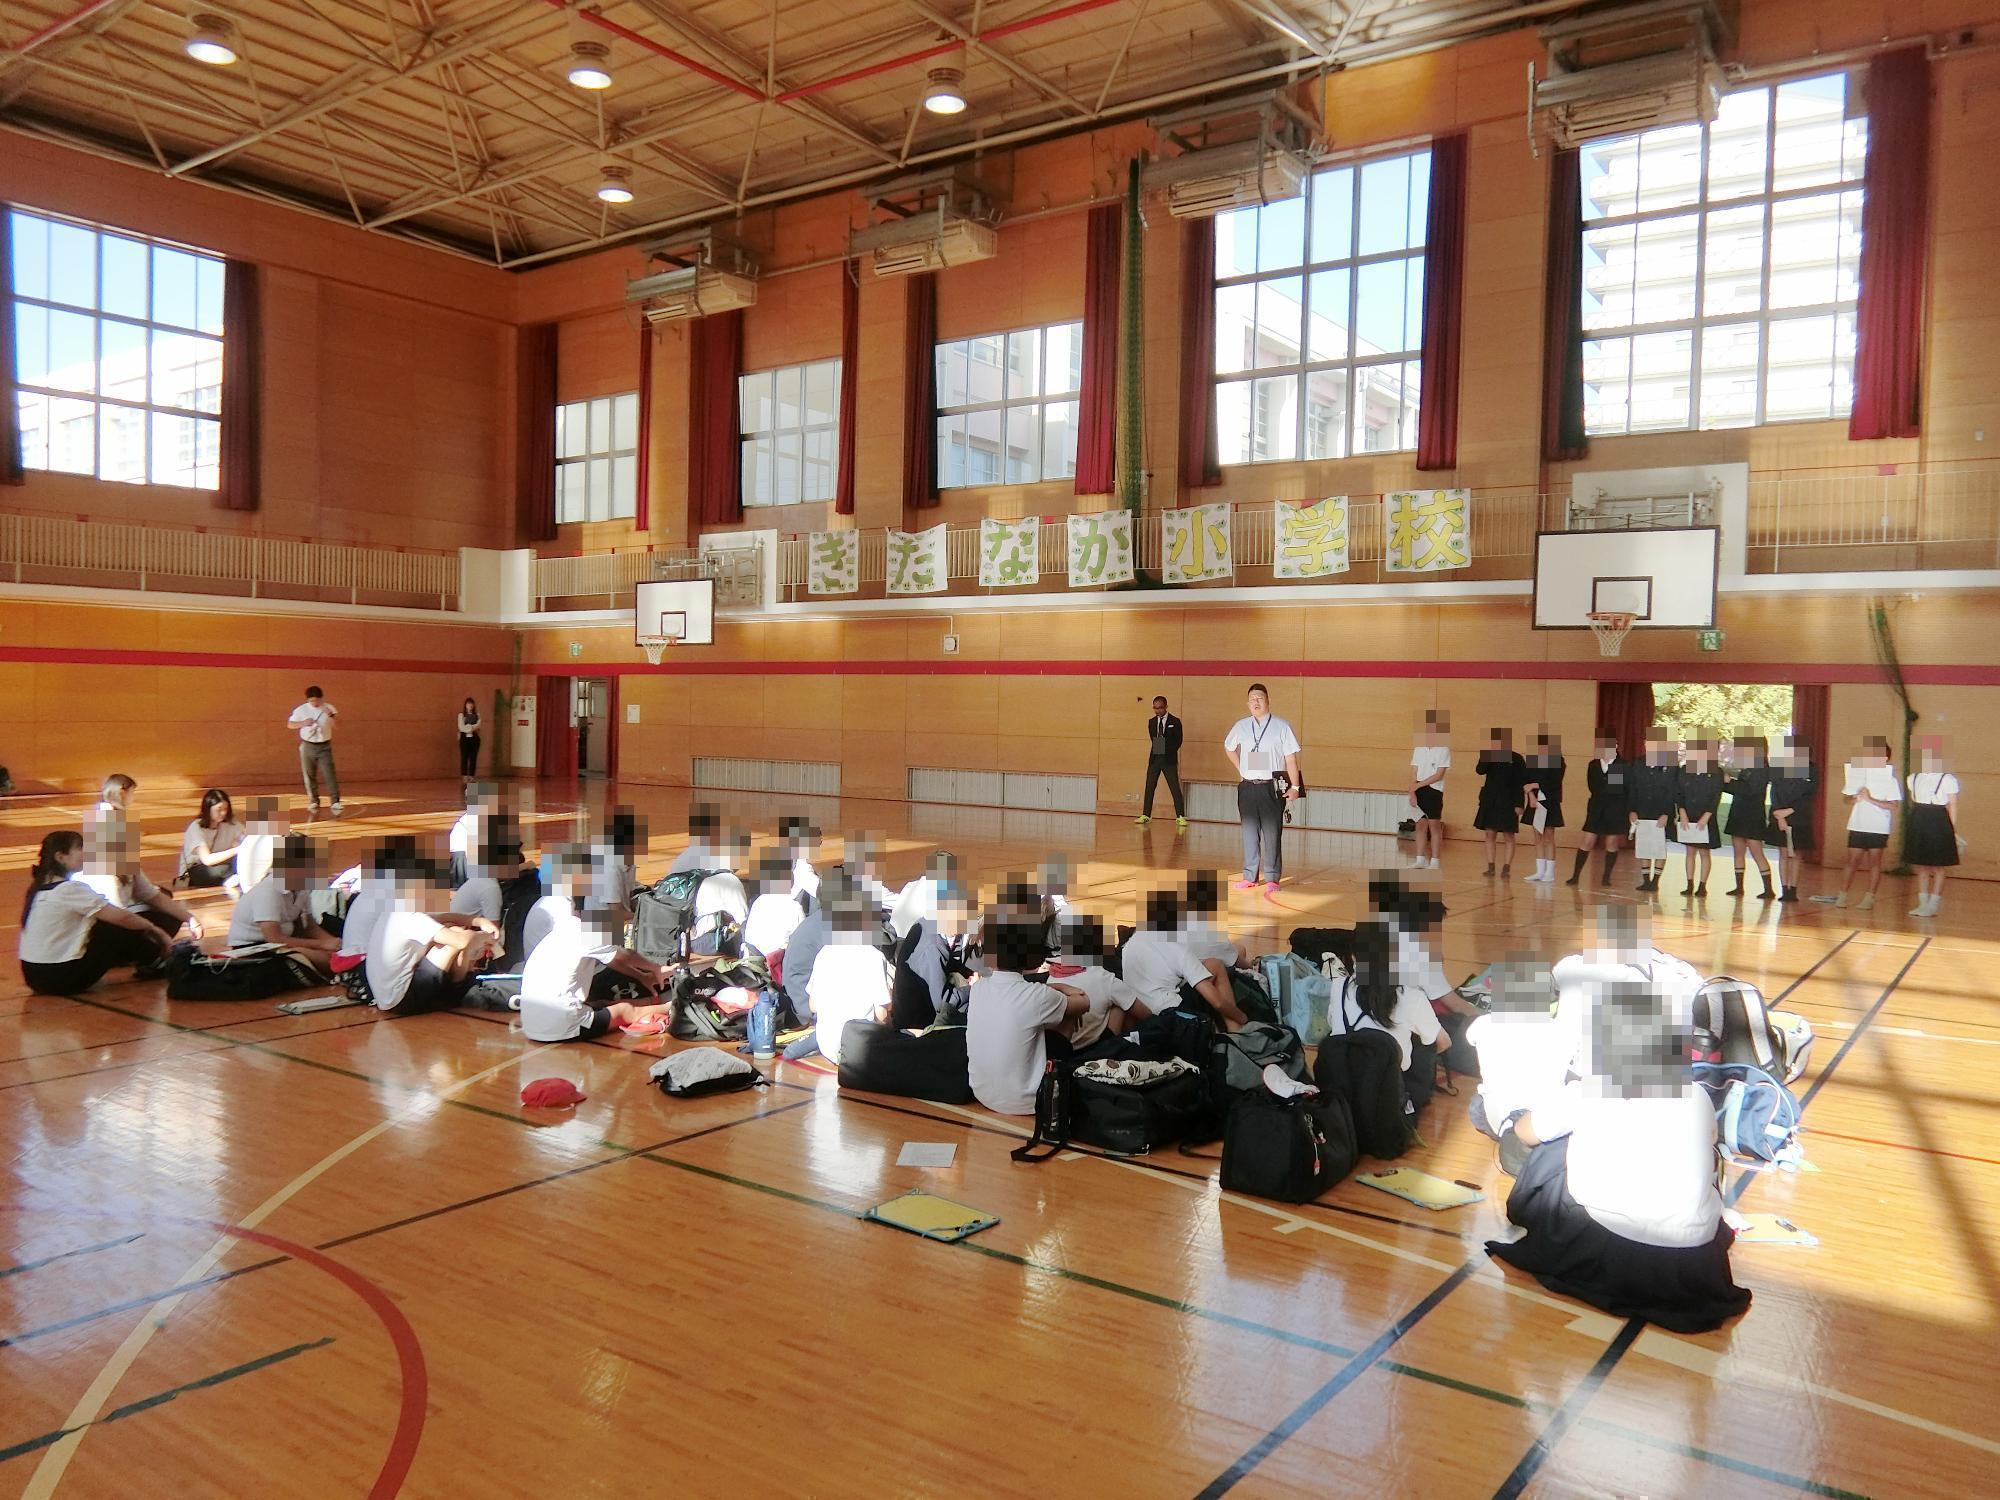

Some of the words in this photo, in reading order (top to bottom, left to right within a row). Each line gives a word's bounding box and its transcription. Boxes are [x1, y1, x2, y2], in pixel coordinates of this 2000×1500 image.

[814, 490, 1468, 588] きたなか小学校
